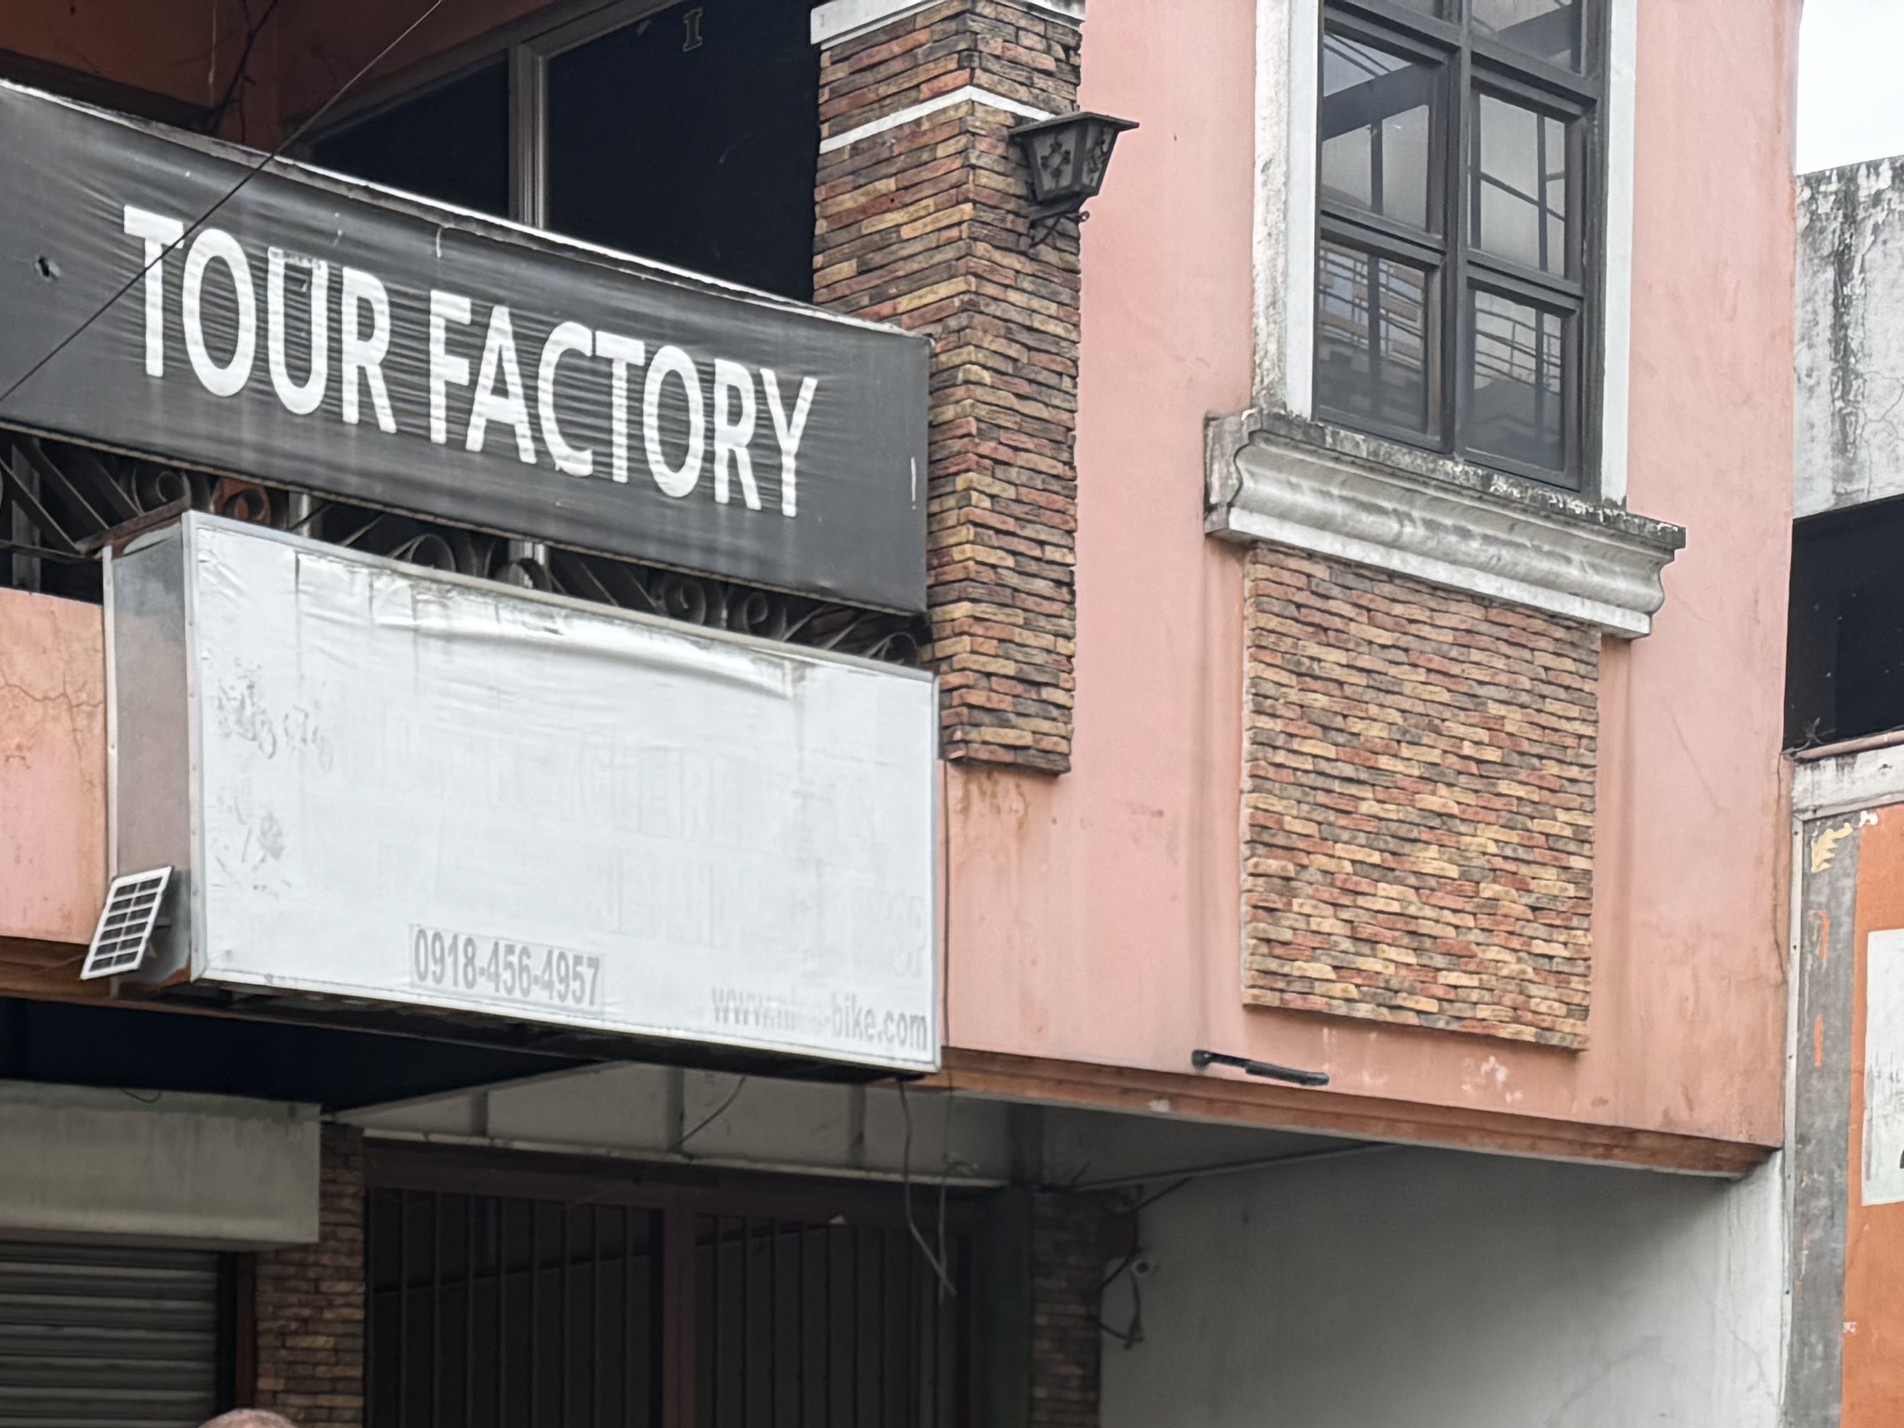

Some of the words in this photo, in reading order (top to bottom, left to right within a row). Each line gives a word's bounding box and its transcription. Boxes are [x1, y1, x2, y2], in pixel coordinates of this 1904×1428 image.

[123, 205, 396, 434] TOUR
[430, 288, 818, 517] FACTORY
[412, 926, 600, 1007] 0918-456-4957
